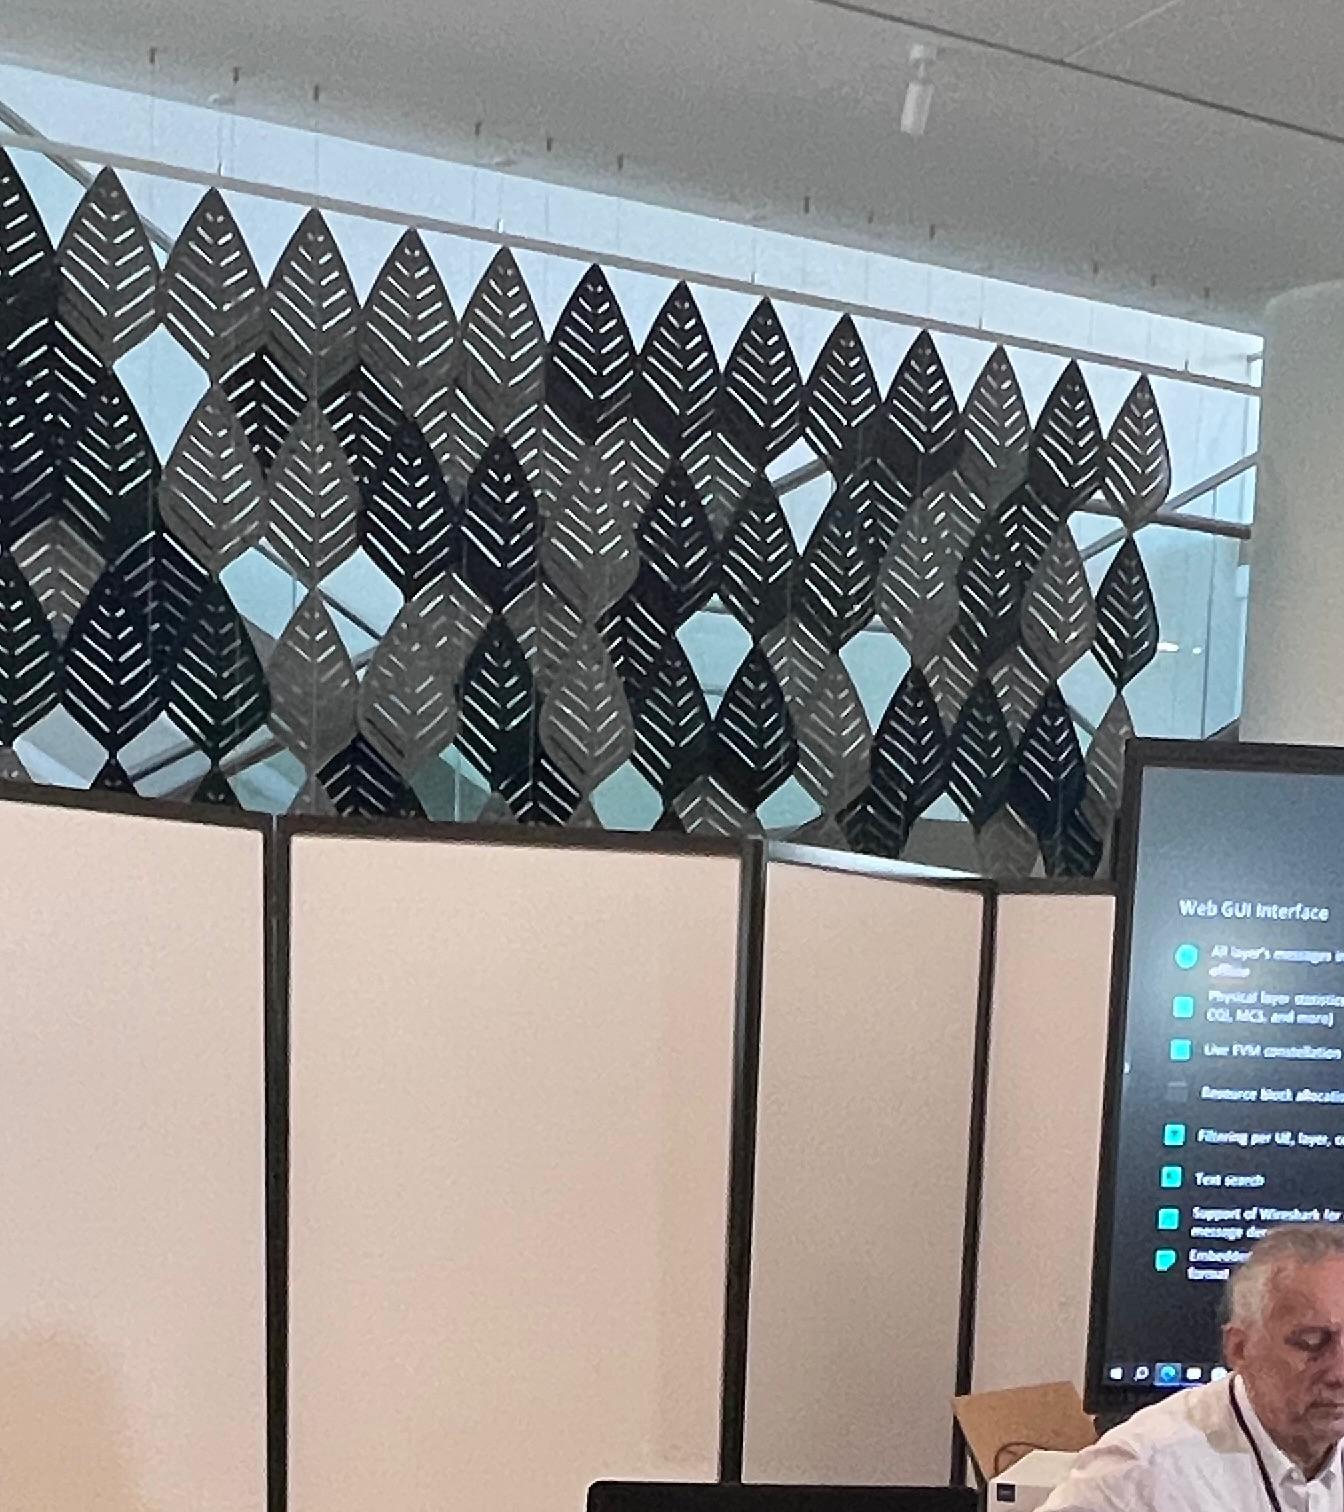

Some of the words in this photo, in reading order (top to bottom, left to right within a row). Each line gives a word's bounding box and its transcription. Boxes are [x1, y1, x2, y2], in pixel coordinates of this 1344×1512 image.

[1179, 899, 1216, 918] Web
[1221, 900, 1252, 919] GUI
[1256, 902, 1330, 921] Interface
[1197, 1128, 1248, 1147] Filtering
[1194, 1172, 1221, 1187] Text
[1224, 1173, 1266, 1188] search
[1192, 1207, 1241, 1223] Support
[1243, 1206, 1258, 1221] of
